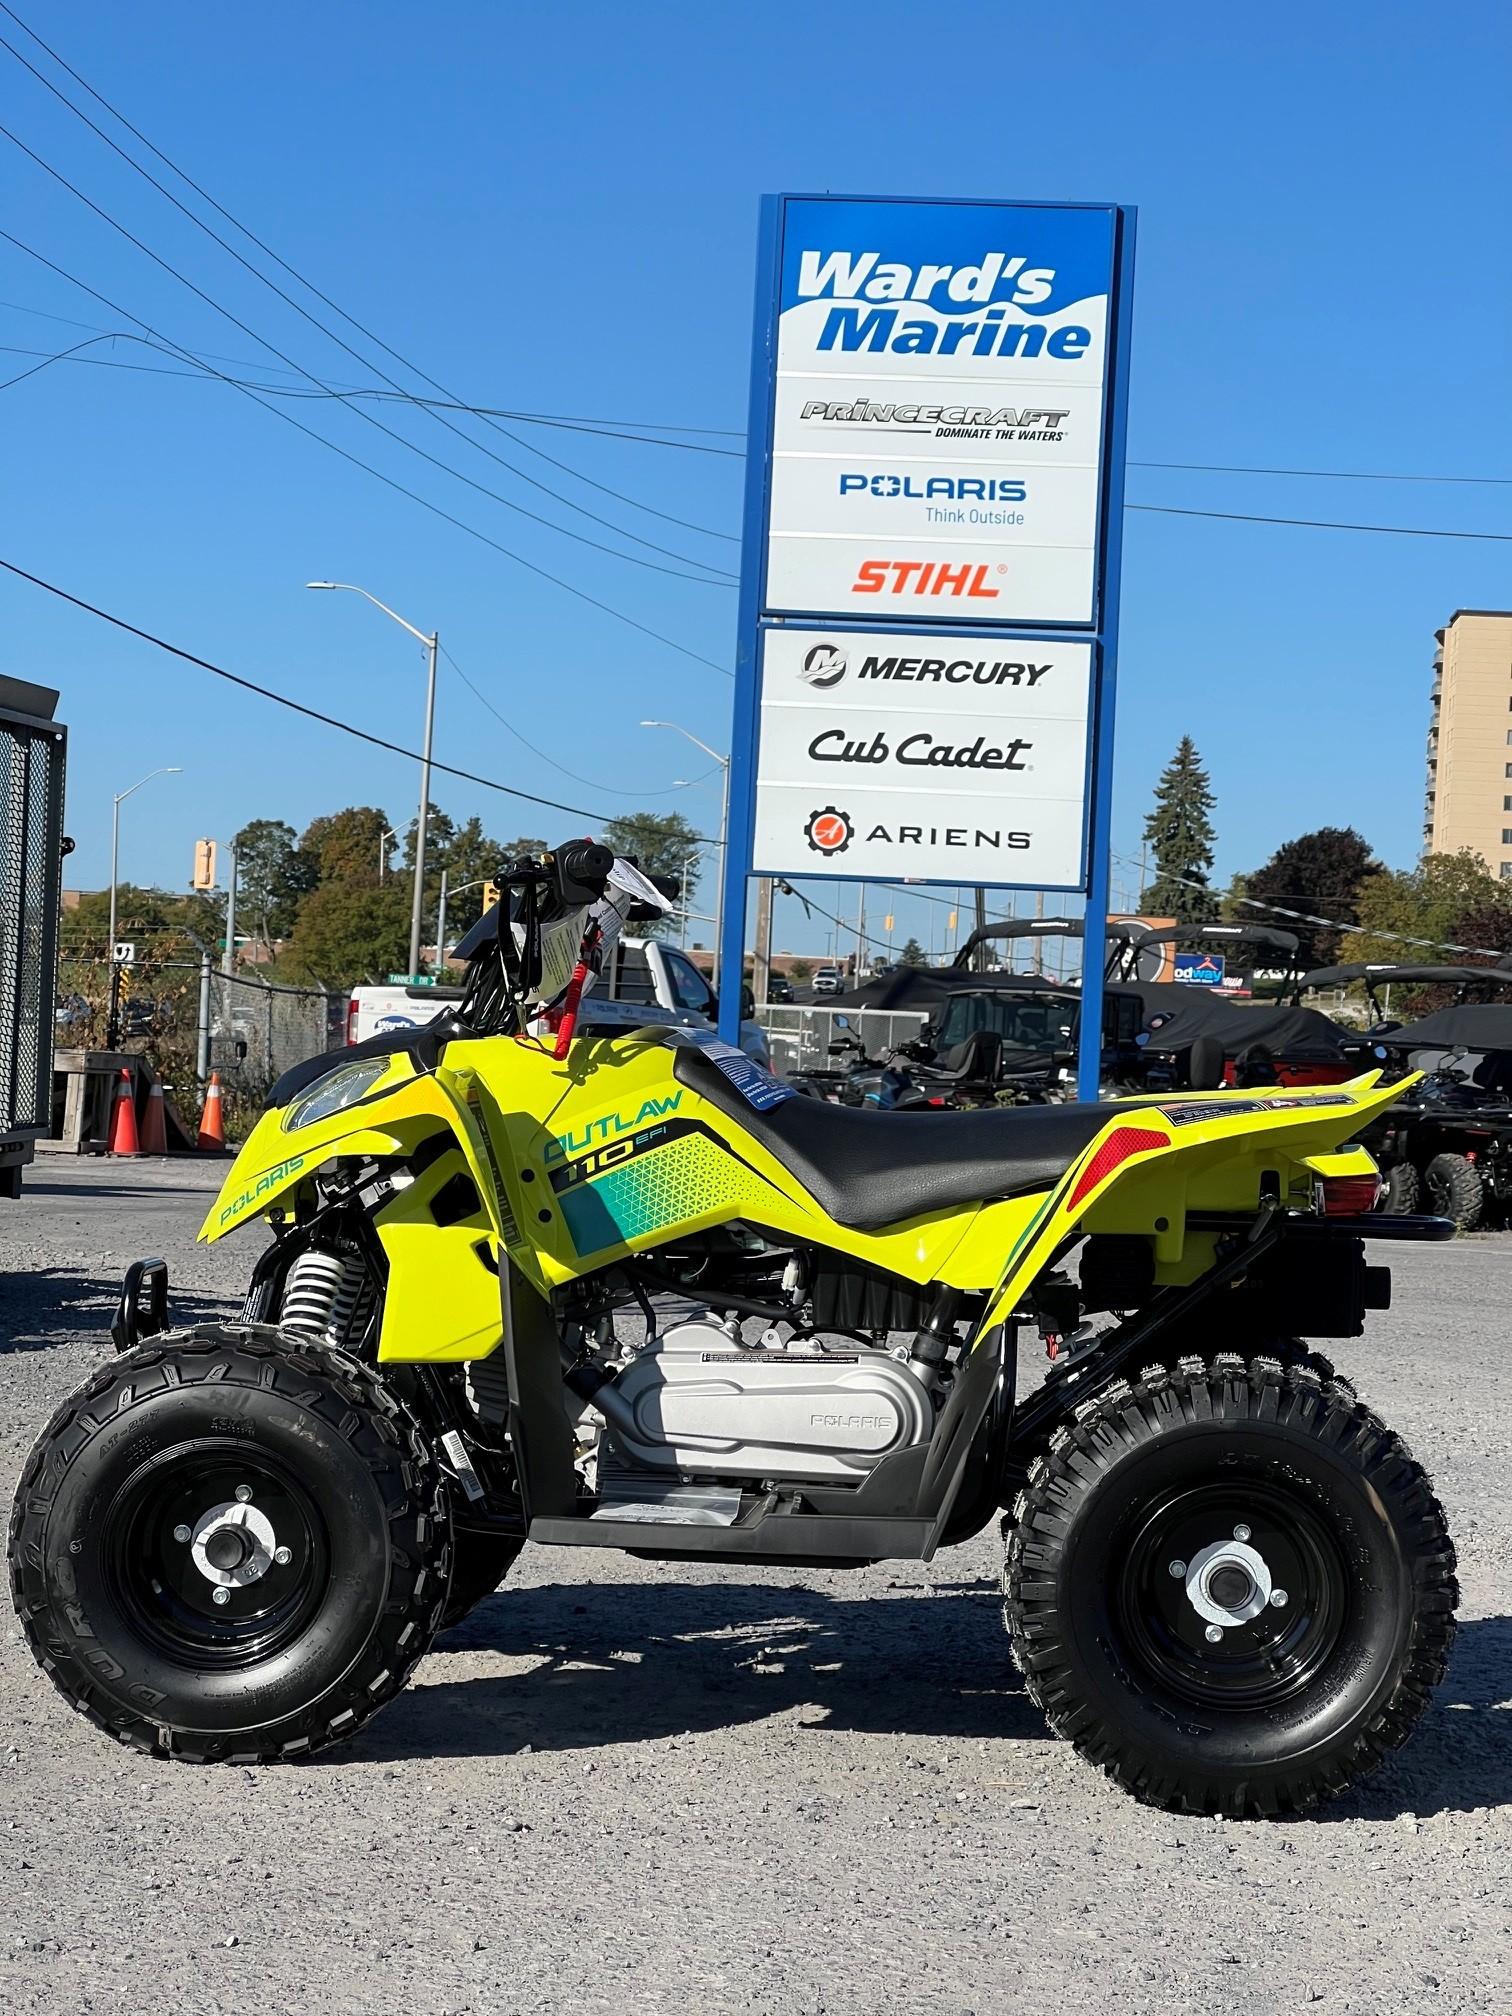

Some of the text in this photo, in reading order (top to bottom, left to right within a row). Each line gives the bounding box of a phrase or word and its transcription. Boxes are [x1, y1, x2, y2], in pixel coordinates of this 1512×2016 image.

[797, 251, 1056, 304] Ward's
[816, 307, 1092, 359] Marine
[800, 398, 1071, 428] PRINCECRAFT
[935, 427, 1064, 442] DOMINATE THE WATERS
[840, 474, 1027, 502] POLARIS
[926, 507, 1025, 526] Think Outside
[852, 560, 1000, 598] STIHL
[858, 656, 1053, 687] MERCURY
[808, 729, 1033, 771] Cub Cadet
[865, 825, 1032, 850] ARIENS
[389, 974, 415, 985] TANNER
[544, 1090, 684, 1165] OUTLAW
[564, 1126, 667, 1183] 110 EFI
[220, 1158, 304, 1226] POLARIS
[811, 1414, 893, 1429] POLARIS
